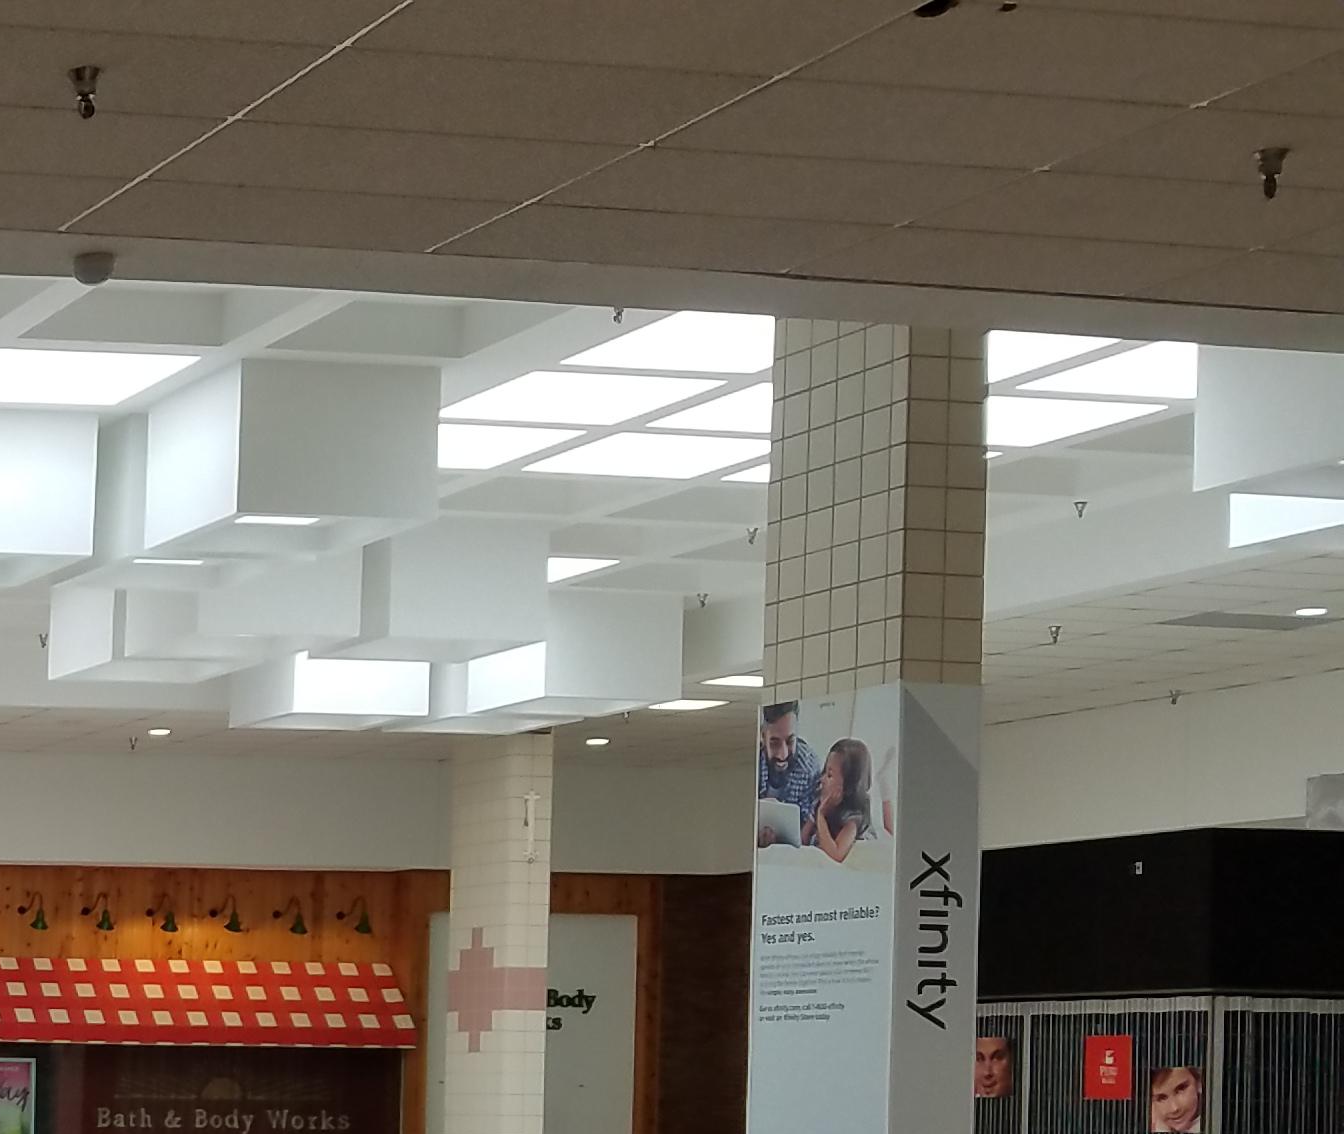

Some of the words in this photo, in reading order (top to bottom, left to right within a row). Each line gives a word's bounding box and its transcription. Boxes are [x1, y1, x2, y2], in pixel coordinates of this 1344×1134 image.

[761, 914, 794, 926] Fastest
[795, 911, 813, 924] and
[814, 909, 837, 922] most
[839, 905, 880, 920] reliable?
[761, 933, 777, 944] Yes
[778, 930, 795, 943] and
[797, 932, 816, 945] yes.
[906, 850, 963, 1030] xfinity
[546, 988, 597, 1015] Body
[96, 1107, 153, 1129] Bath
[164, 1109, 183, 1129] &
[267, 1109, 351, 1130] Works
